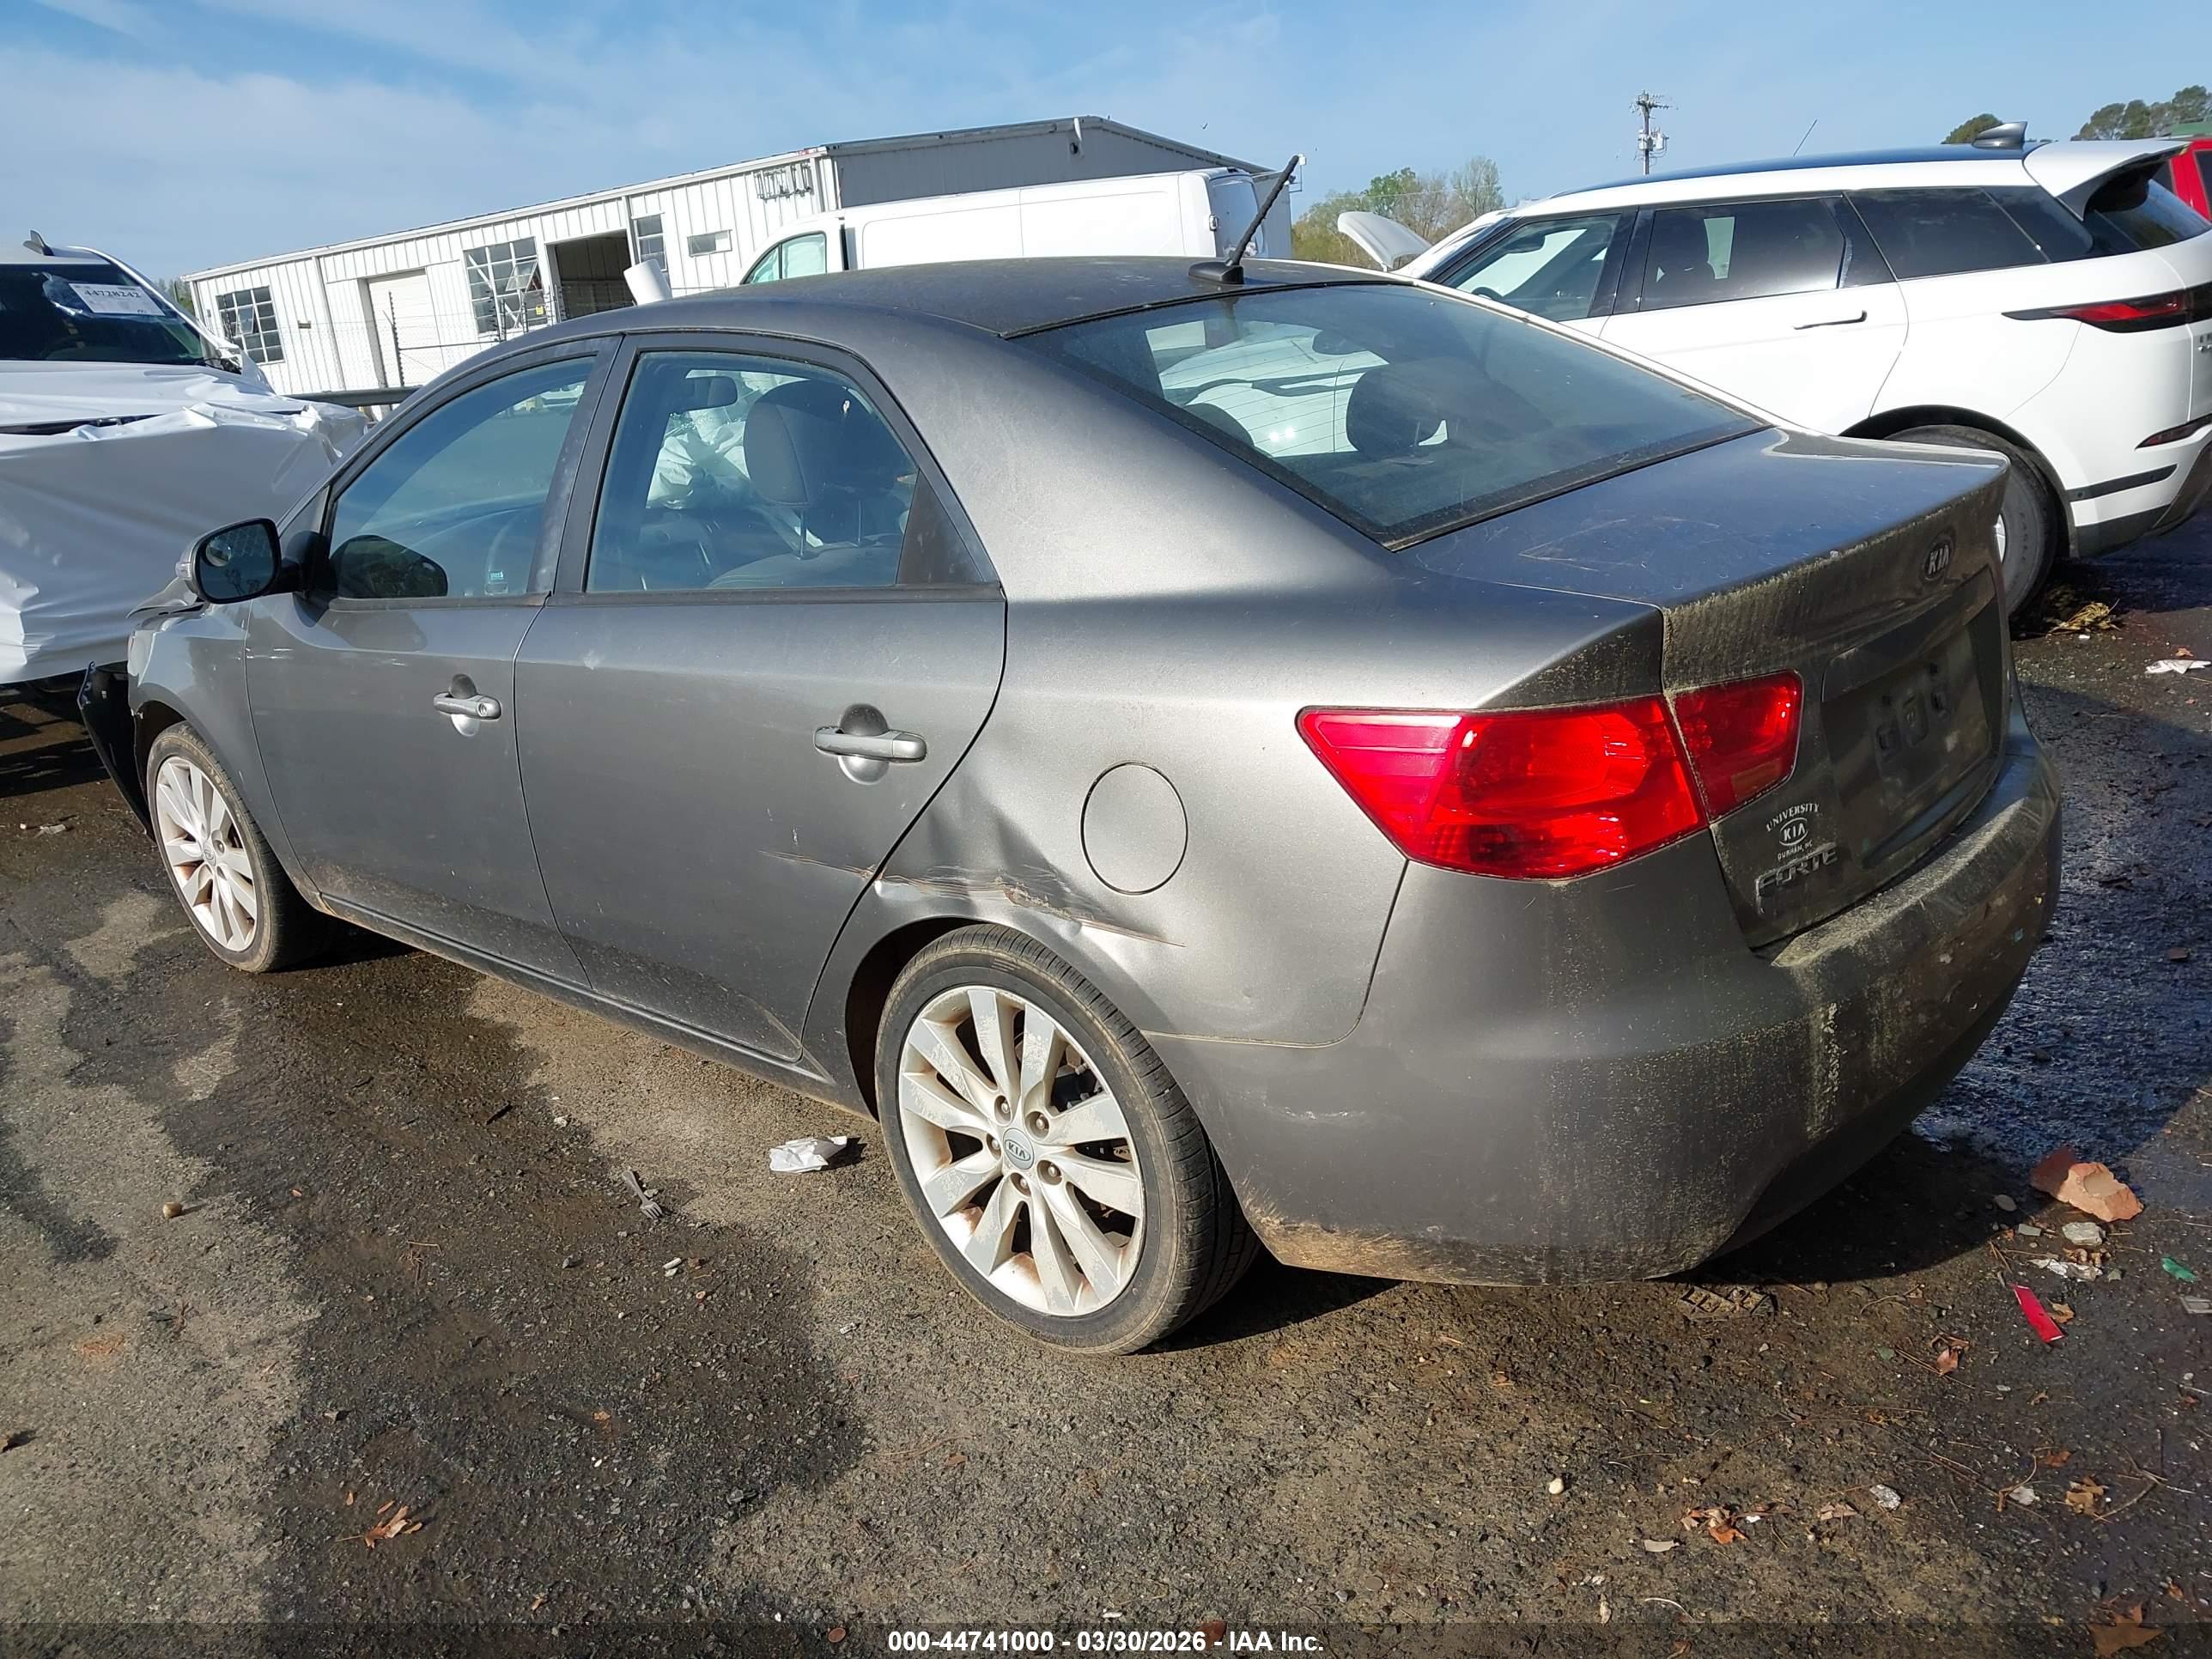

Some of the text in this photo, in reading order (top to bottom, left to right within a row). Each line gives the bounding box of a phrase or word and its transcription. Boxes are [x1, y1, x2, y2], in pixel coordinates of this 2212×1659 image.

[1929, 544, 1949, 574] KIA
[1766, 803, 1820, 831] UNIVERSITY
[1784, 823, 1806, 841] KIA
[1805, 839, 1814, 850] NC
[1755, 842, 1838, 915] FORTE
[1008, 1142, 1026, 1159] KIA
